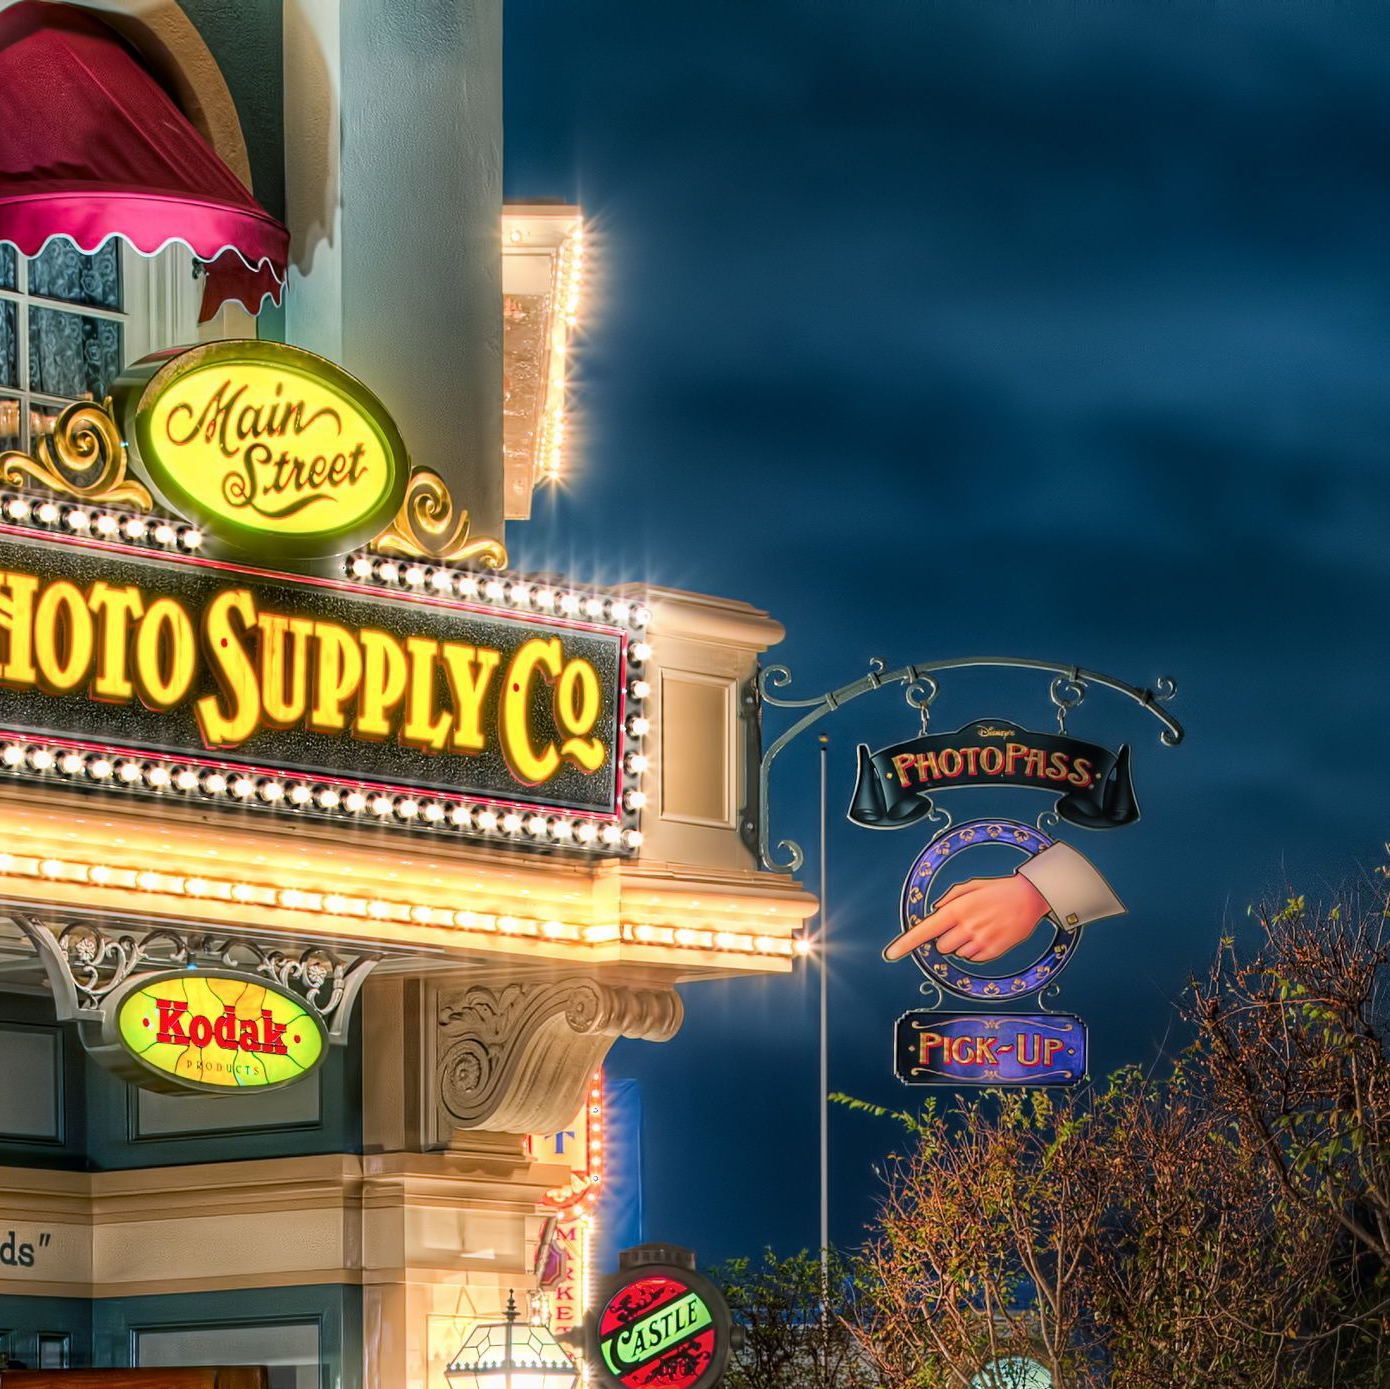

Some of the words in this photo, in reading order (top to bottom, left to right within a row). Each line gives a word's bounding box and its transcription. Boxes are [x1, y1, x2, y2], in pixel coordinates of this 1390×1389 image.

[166, 379, 343, 453] Main
[222, 444, 368, 519] Street
[194, 588, 500, 751] SUPPLY
[156, 999, 288, 1055] Kodak
[918, 1032, 1065, 1067] PICK-UP
[186, 1060, 261, 1076] PRODUCTS
[610, 1299, 698, 1368] CASTLE
